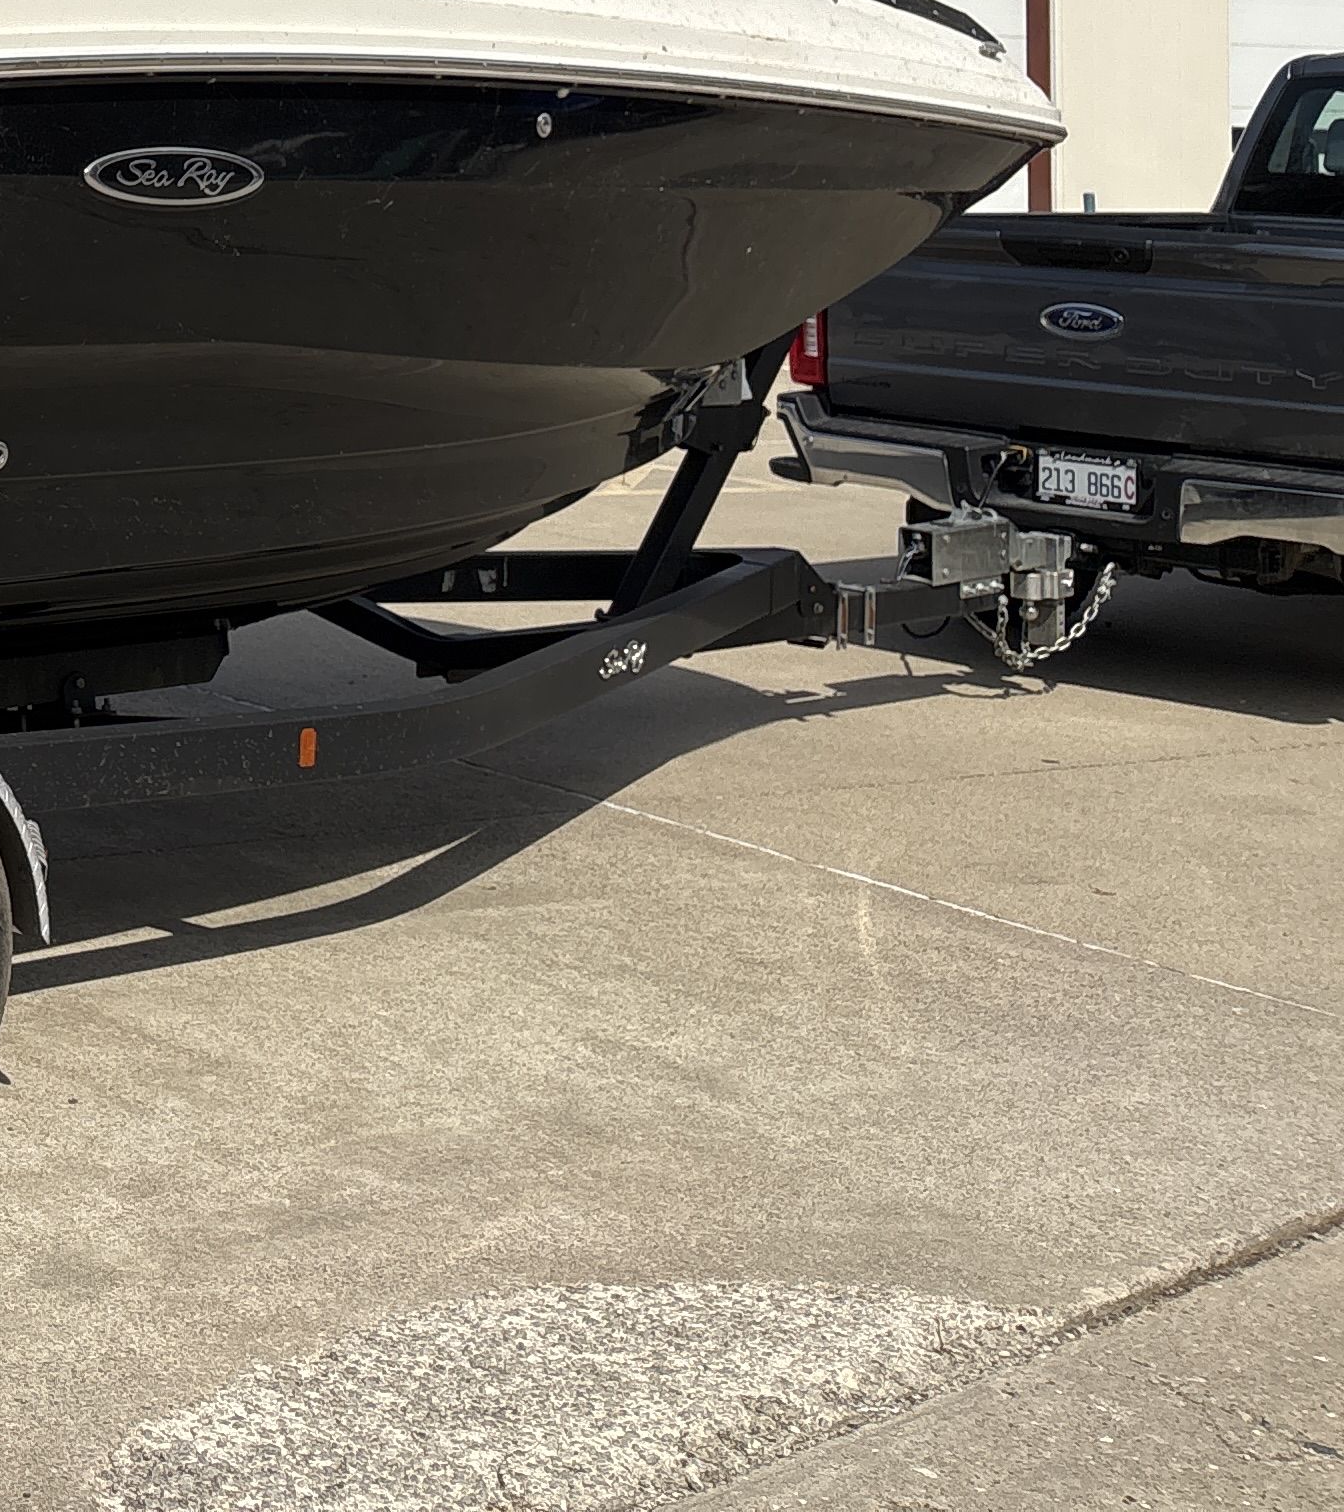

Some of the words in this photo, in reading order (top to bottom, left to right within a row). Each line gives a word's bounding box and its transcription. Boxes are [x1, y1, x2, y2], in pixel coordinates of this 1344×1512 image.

[116, 159, 175, 187] Sea
[177, 157, 235, 196] Ray
[1058, 309, 1103, 330] Ford
[1123, 355, 1344, 391] DUTY
[1041, 466, 1076, 494] 213
